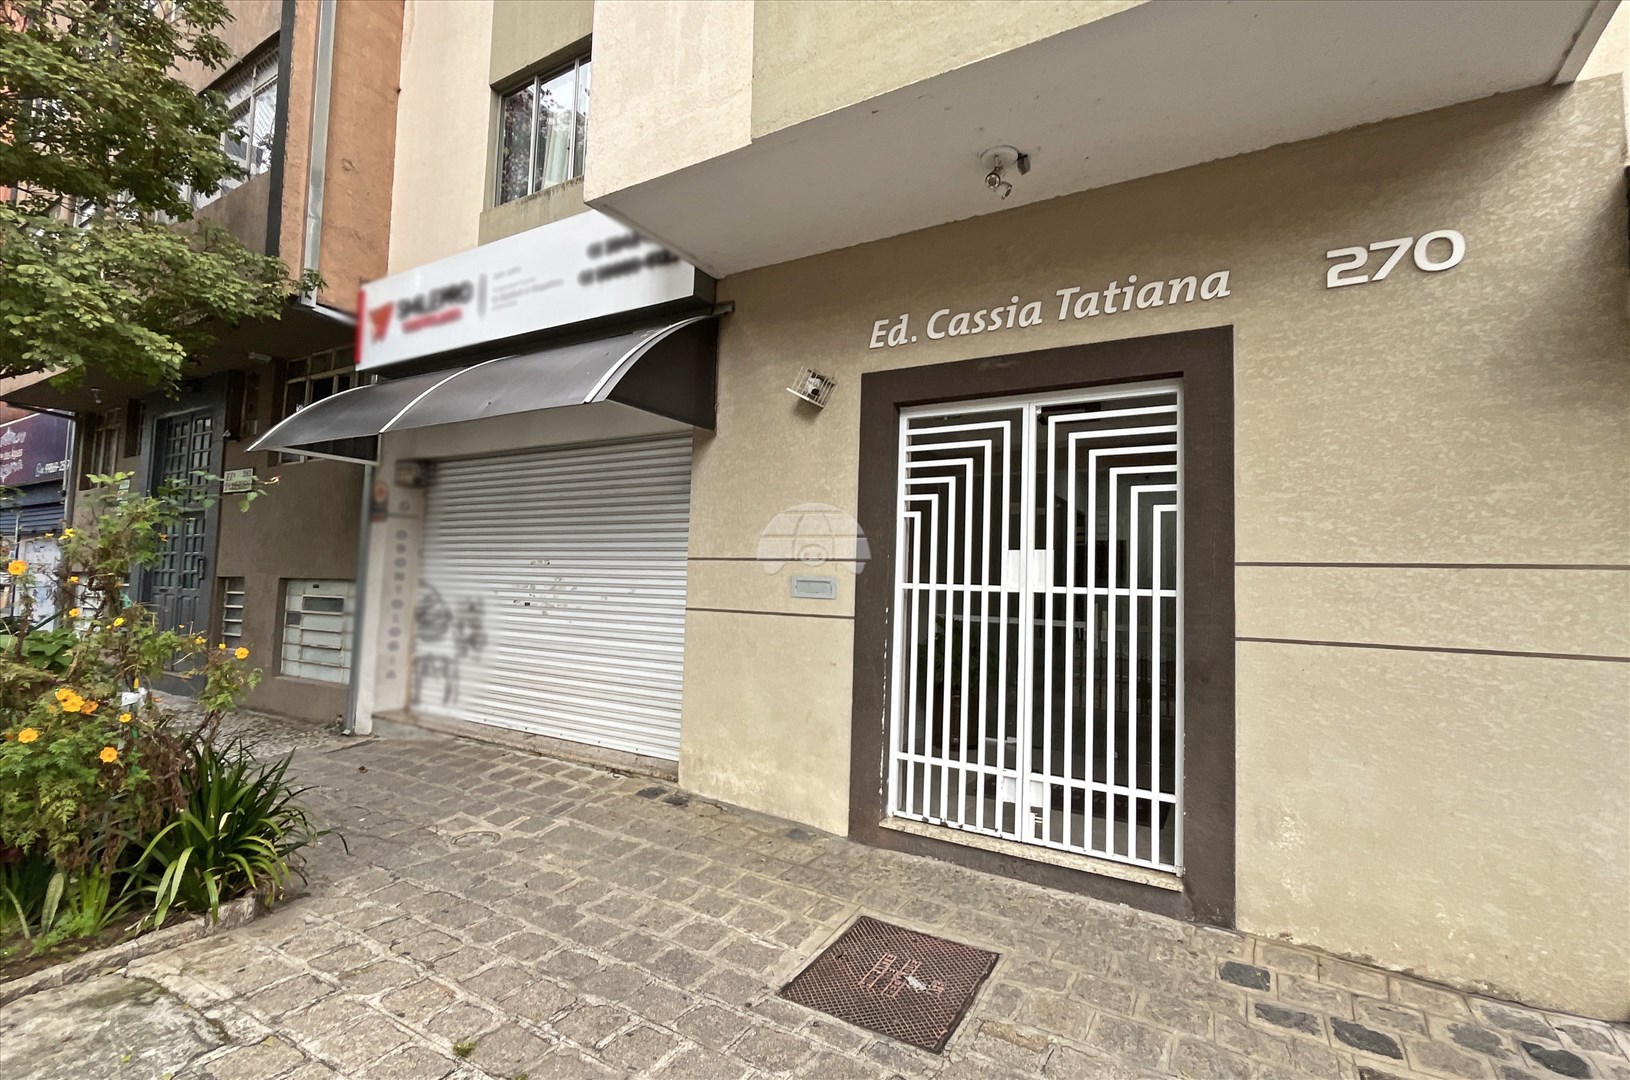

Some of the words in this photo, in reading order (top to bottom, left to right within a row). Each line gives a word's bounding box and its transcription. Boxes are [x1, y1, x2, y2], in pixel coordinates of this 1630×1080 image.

[1326, 229, 1466, 289] 270
[869, 314, 917, 349] Ed.
[926, 295, 1043, 340] Cassia
[1056, 270, 1232, 321] Tatiana
